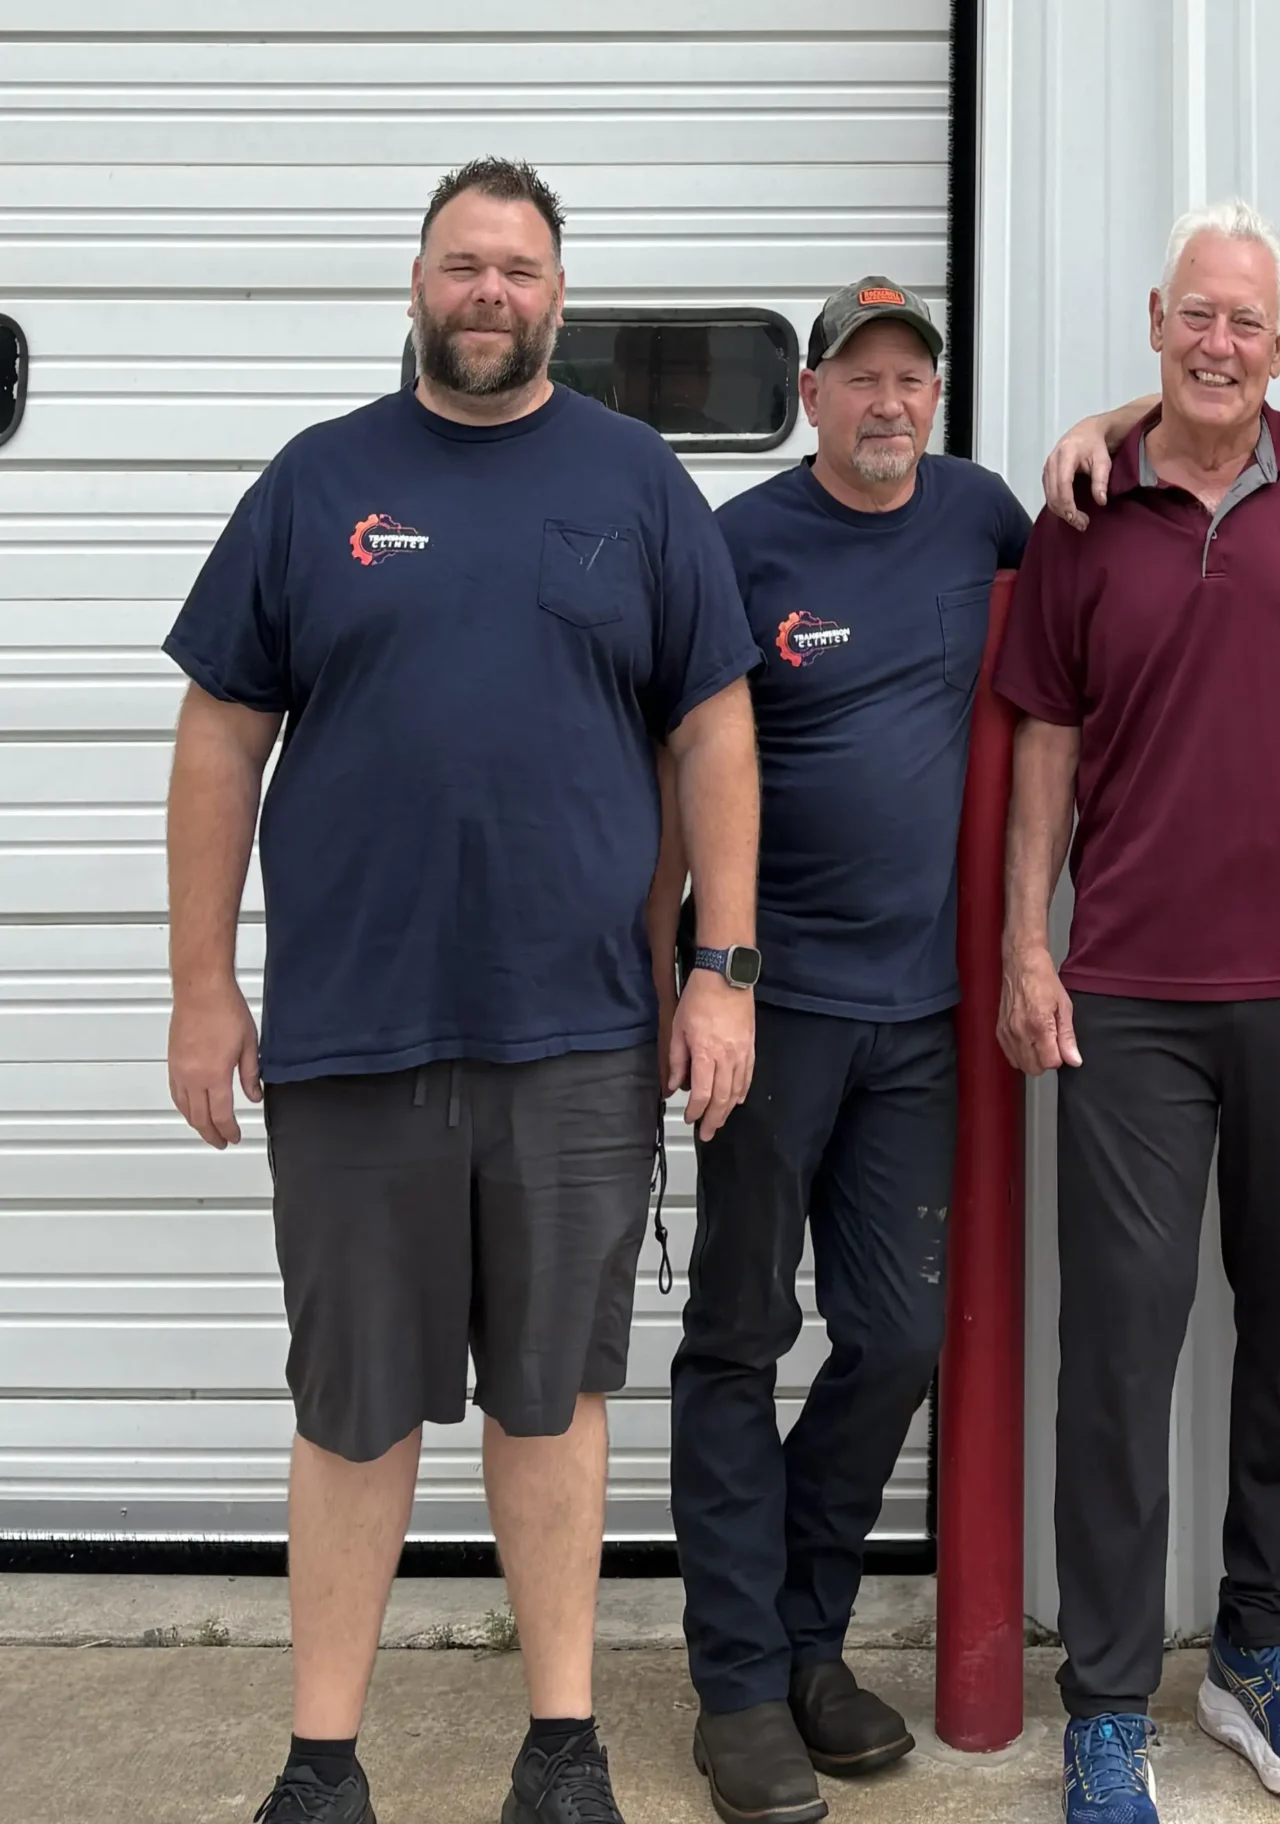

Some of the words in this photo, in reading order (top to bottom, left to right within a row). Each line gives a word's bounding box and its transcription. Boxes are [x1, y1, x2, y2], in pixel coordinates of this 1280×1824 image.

[371, 541, 425, 549] CLINICS
[793, 628, 850, 642] TRANSMISSION
[798, 635, 848, 647] CLINICS
